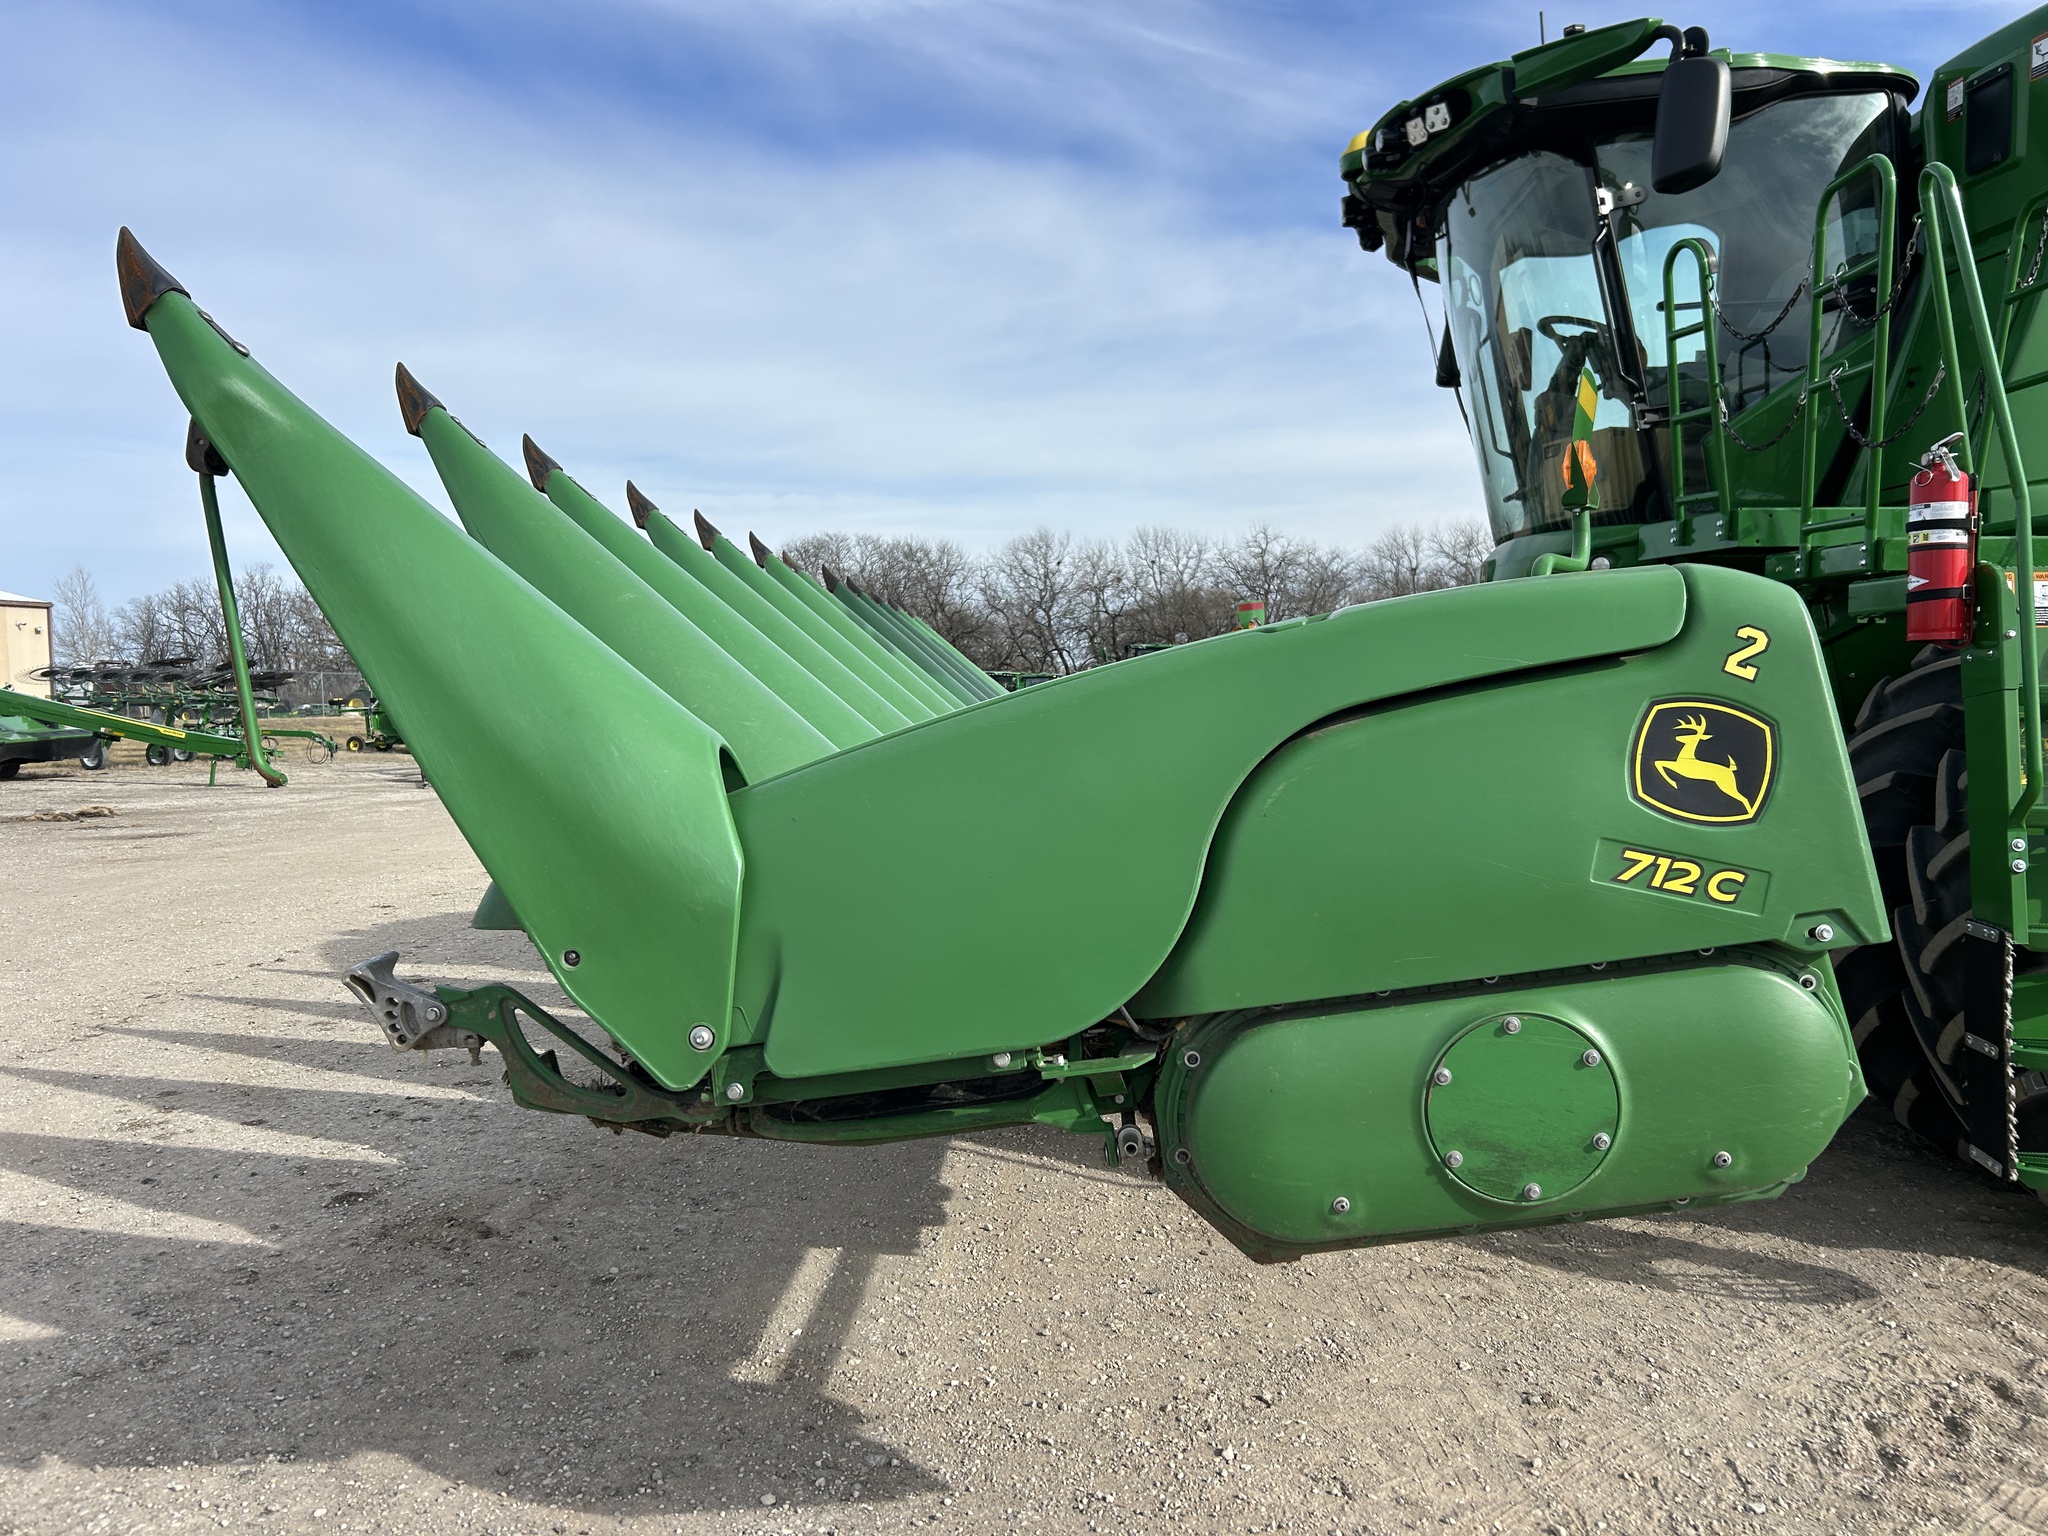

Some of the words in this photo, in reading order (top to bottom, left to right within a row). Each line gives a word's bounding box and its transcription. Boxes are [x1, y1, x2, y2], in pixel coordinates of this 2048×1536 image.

[1722, 625, 1771, 682] 2
[1612, 847, 1704, 897] 712
[1704, 868, 1749, 904] C
